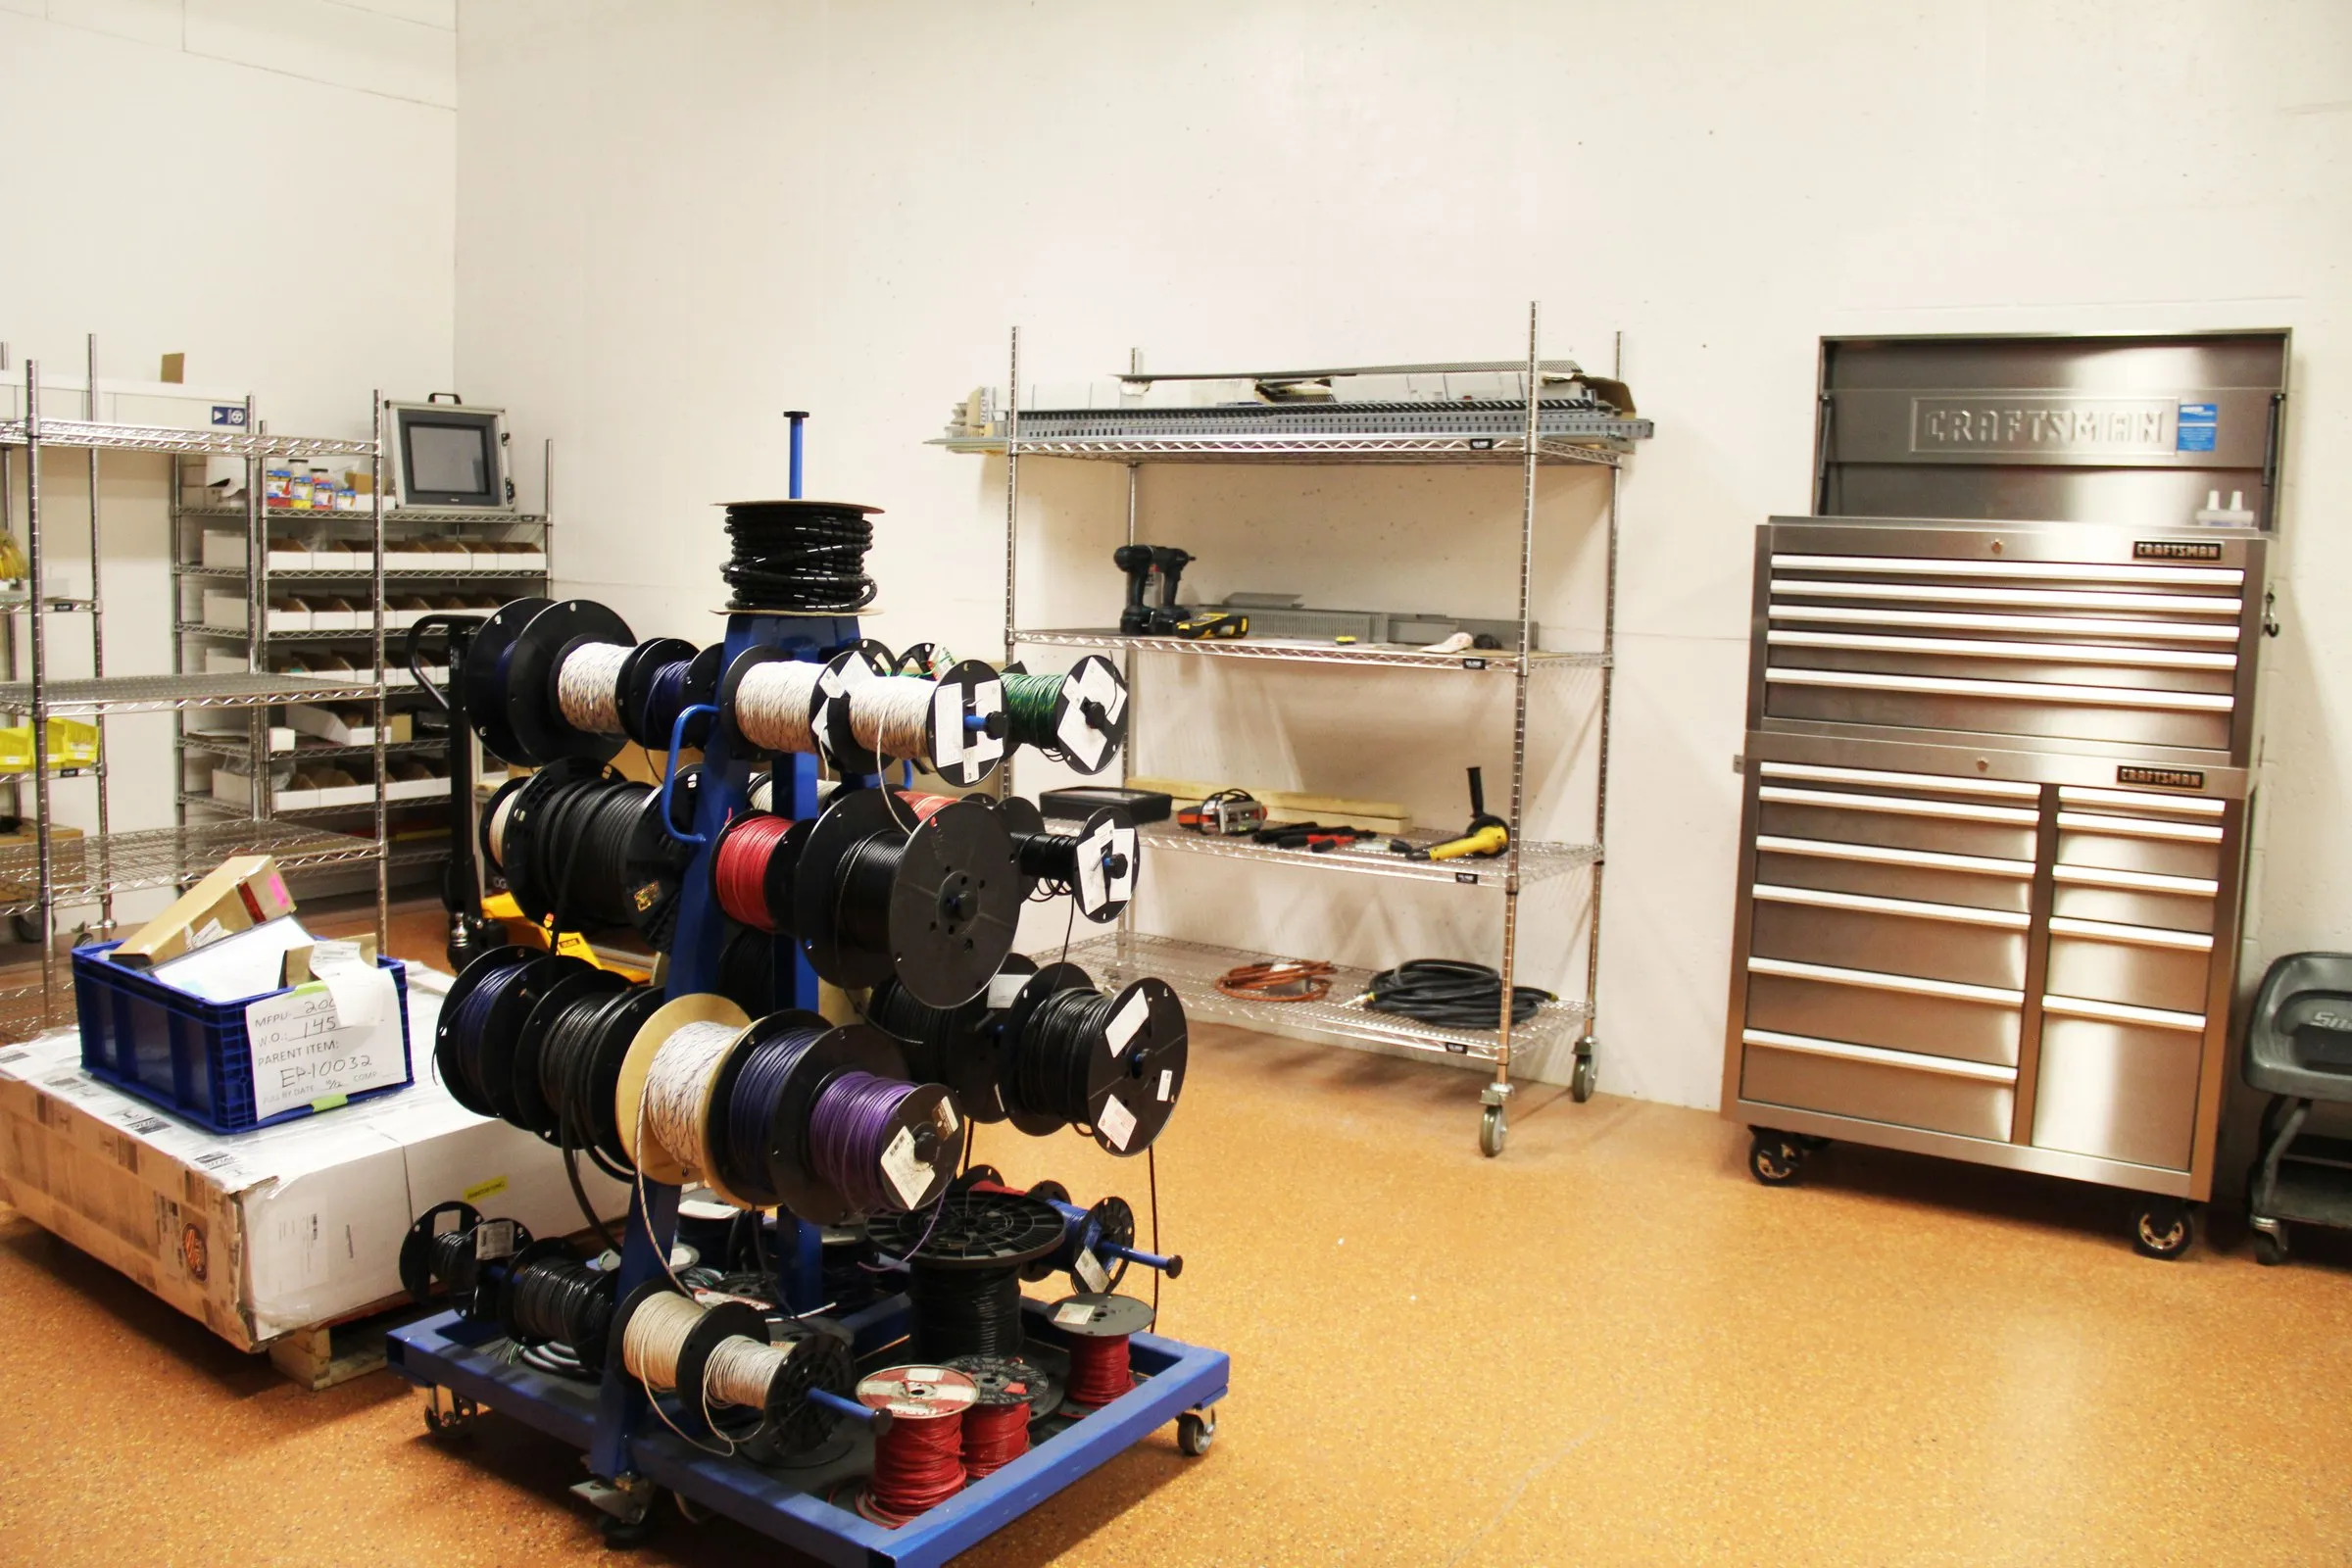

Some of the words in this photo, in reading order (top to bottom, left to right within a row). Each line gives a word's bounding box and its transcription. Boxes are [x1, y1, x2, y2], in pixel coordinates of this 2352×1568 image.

[1925, 410, 2163, 442] CRAFTSMAN
[2137, 543, 2218, 558] CRAFTSMAN
[2121, 768, 2200, 786] CRAFTSMAN
[258, 1047, 302, 1066] PARENT
[306, 1040, 340, 1055] ITEM:
[294, 1085, 315, 1097] DATE
